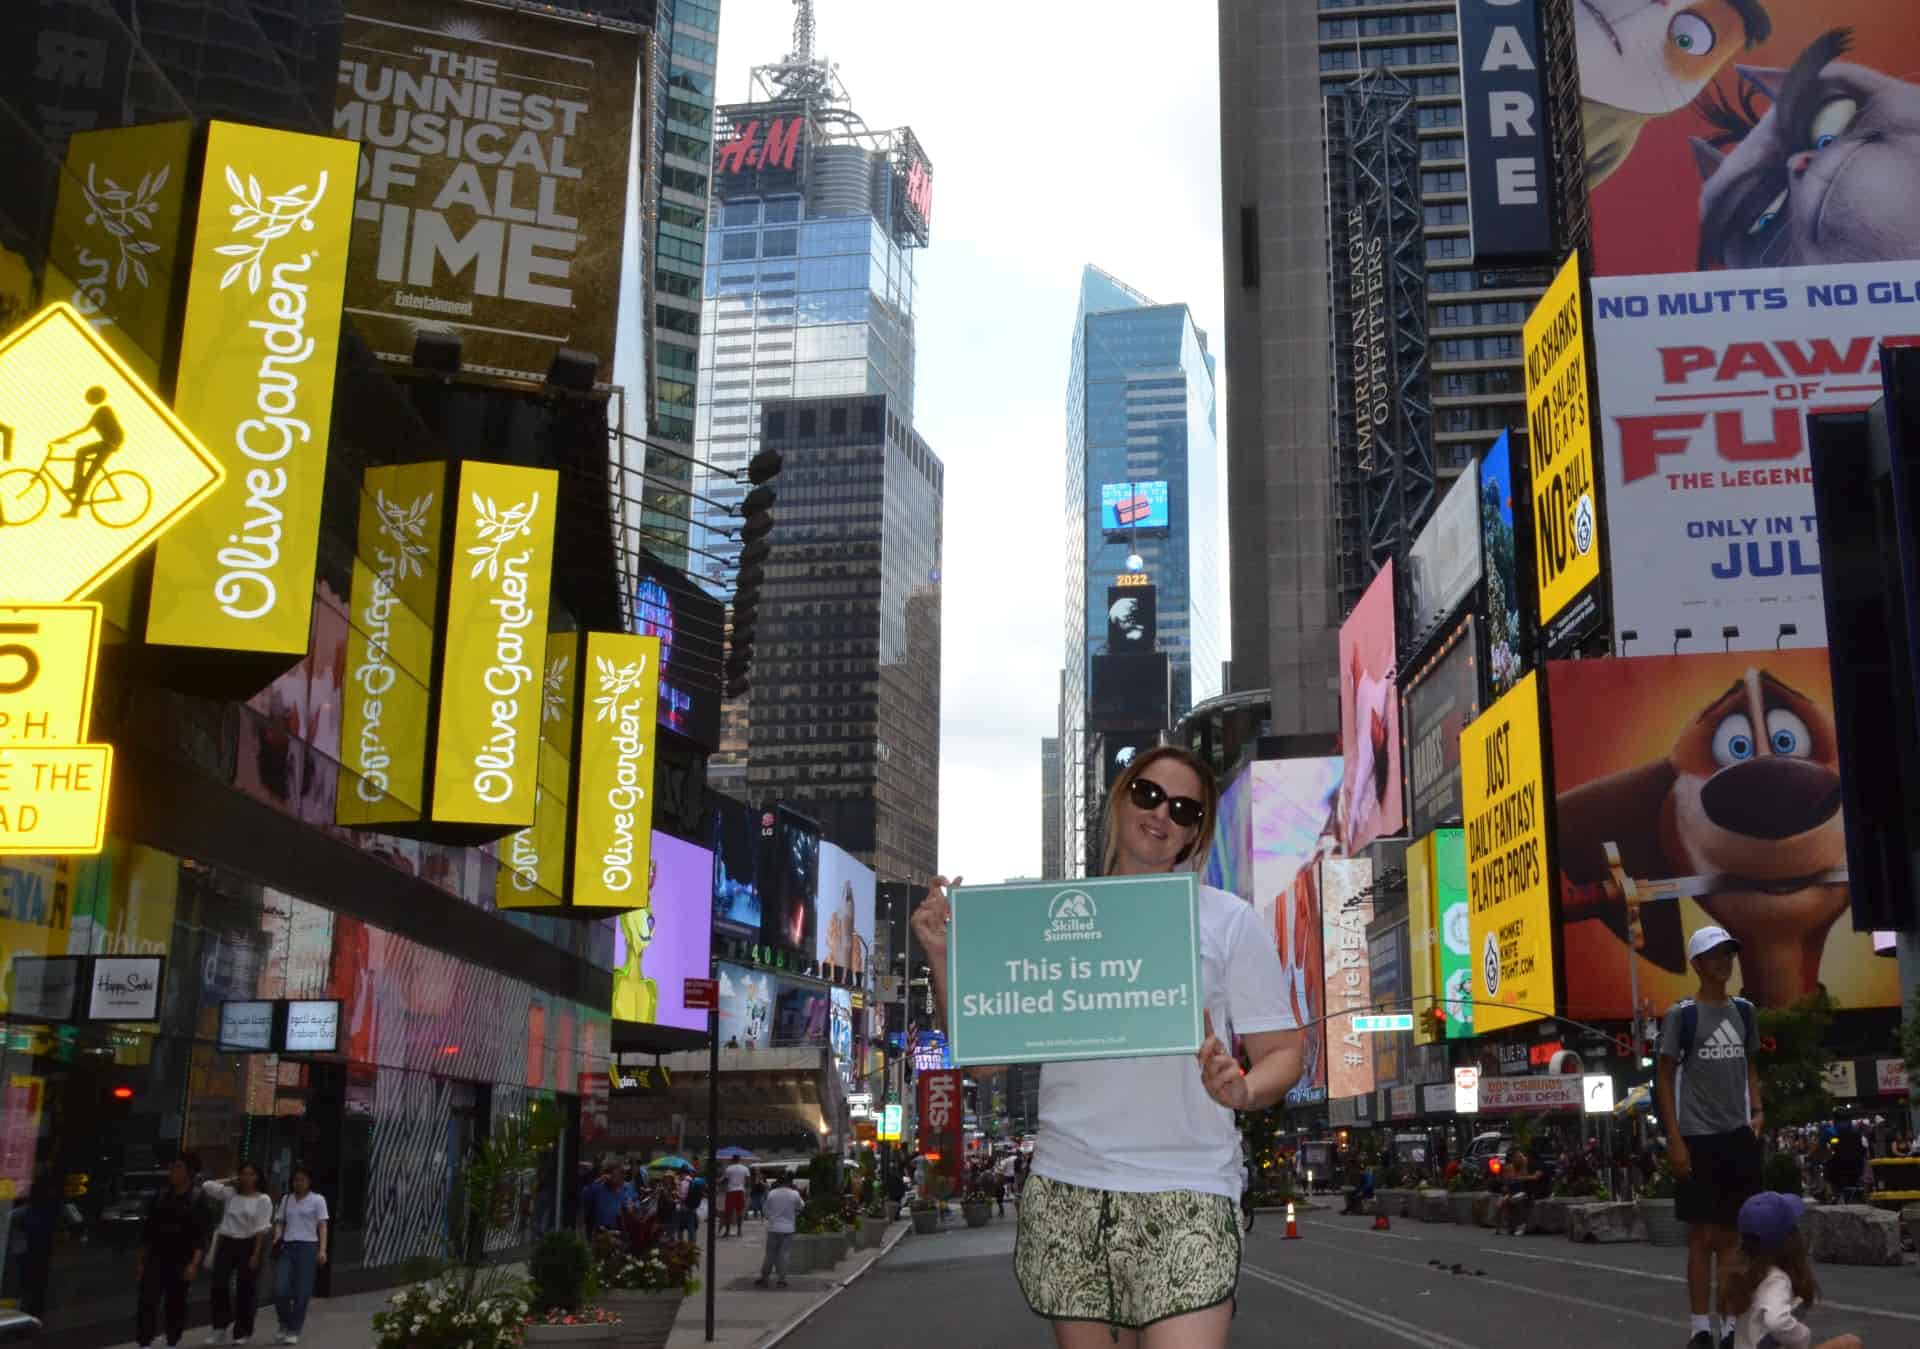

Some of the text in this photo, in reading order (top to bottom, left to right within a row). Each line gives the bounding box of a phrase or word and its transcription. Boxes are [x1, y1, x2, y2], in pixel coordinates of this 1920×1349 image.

[1481, 0, 1538, 206] ARE
[719, 115, 804, 175] H&M
[432, 161, 578, 230] ALL
[907, 160, 933, 225] H&M
[394, 290, 473, 316] Entertainment
[1599, 281, 1920, 319] NO MUTTS NO GL
[1348, 204, 1374, 472] AMERICAN EAGLE
[1366, 236, 1389, 426] OUTFITTERS
[1528, 294, 1578, 393] NO SHARKS
[1531, 352, 1582, 481] NO SALARY
[1775, 381, 1820, 401] OF
[214, 253, 315, 619] Olive Garden
[1554, 397, 1585, 455] CAPS
[1666, 473, 1715, 490] THE
[1538, 448, 1589, 588] NO BULL
[1687, 519, 1757, 538] ONLY
[1766, 516, 1792, 535] IN
[1116, 574, 1148, 586] 2022
[1711, 539, 1821, 578] JUL
[474, 552, 532, 803] Olive Garden
[32, 763, 94, 791] THE
[1484, 720, 1511, 799] JUST
[602, 699, 645, 891] Olive Garden
[1468, 780, 1536, 865] DAILY FANTASY
[761, 827, 774, 837] LG
[1472, 838, 1539, 916] PLAYER PROPS
[1044, 928, 1102, 942] Summers
[1052, 917, 1094, 932] Skilled
[1006, 957, 1143, 982] This is my
[962, 983, 1188, 1017] Skilled Summer!
[928, 1074, 955, 1126] tkts
